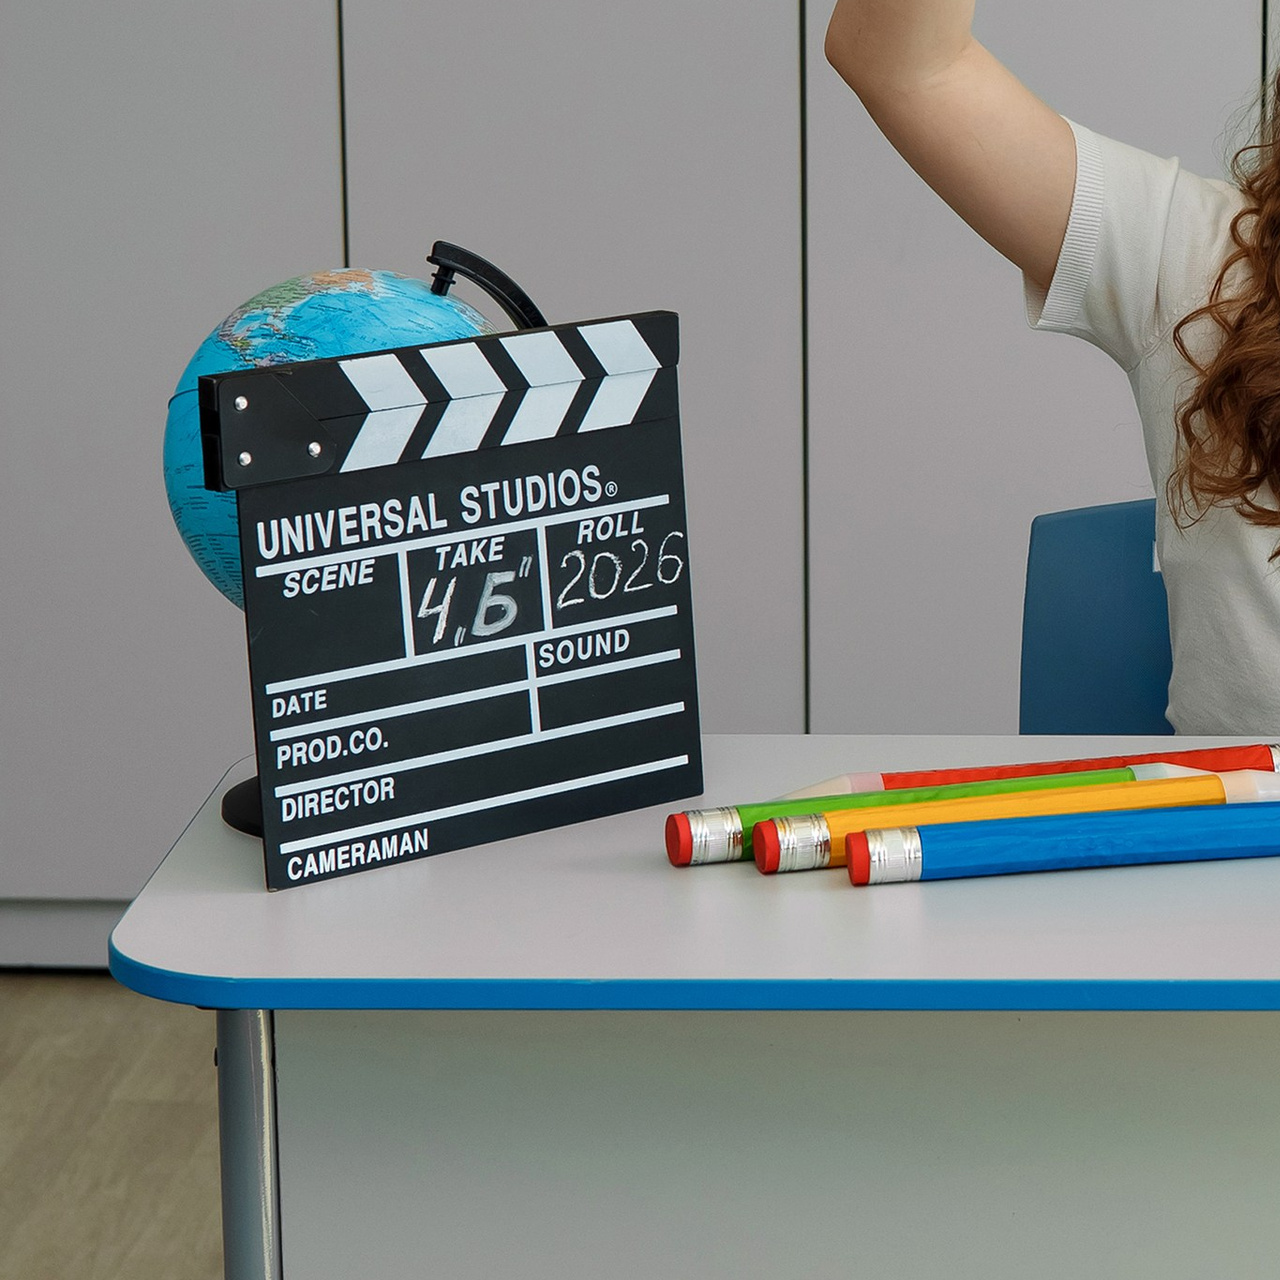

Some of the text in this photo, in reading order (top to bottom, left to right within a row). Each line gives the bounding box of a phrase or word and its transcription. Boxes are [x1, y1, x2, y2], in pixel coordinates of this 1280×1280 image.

[257, 492, 448, 561] UNIVERSAL
[576, 511, 645, 545] ROLL
[435, 536, 505, 572] TAKE
[556, 531, 685, 610] 2026
[283, 558, 375, 599] SCENE
[538, 628, 631, 669] SOUND
[272, 689, 328, 719] DATE
[281, 776, 396, 823] DIRECTOR
[287, 827, 429, 882] CAMERAMAN
